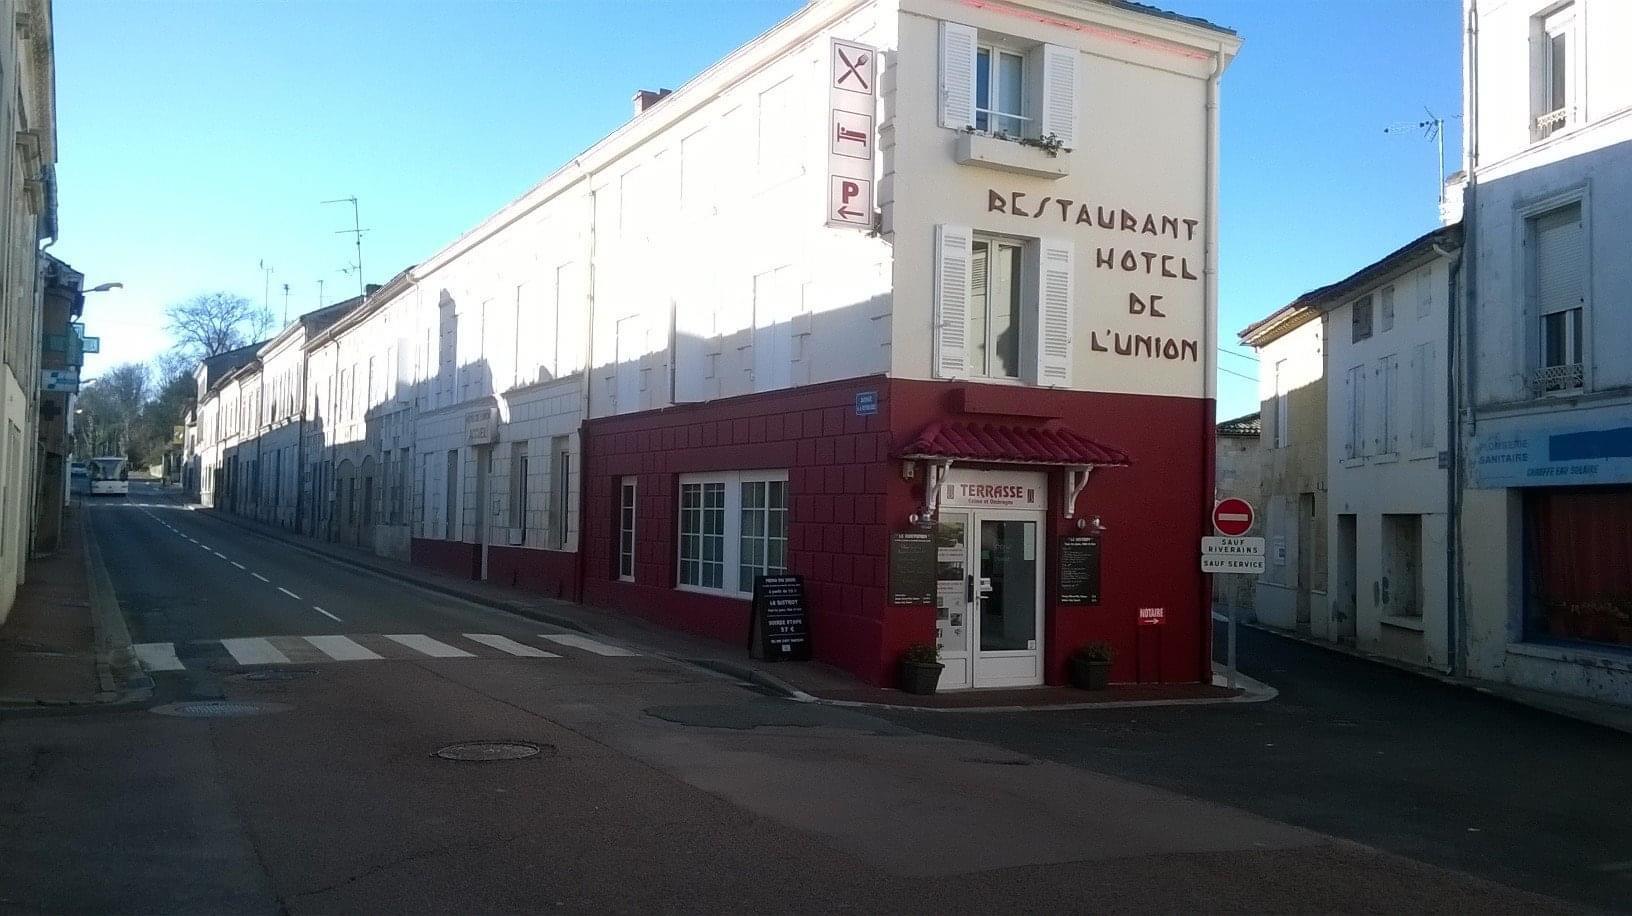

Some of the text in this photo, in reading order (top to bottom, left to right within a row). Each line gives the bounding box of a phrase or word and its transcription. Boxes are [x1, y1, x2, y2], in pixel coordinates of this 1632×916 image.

[842, 181, 859, 204] P
[988, 188, 1198, 240] RESTAURANT
[1096, 247, 1198, 280] HOTEL
[1129, 292, 1166, 317] DE
[1091, 329, 1198, 362] L'UNION
[1479, 453, 1529, 465] SANITAIRE
[960, 483, 1023, 499] TERRASSE
[1208, 546, 1258, 554] RIVERAINS
